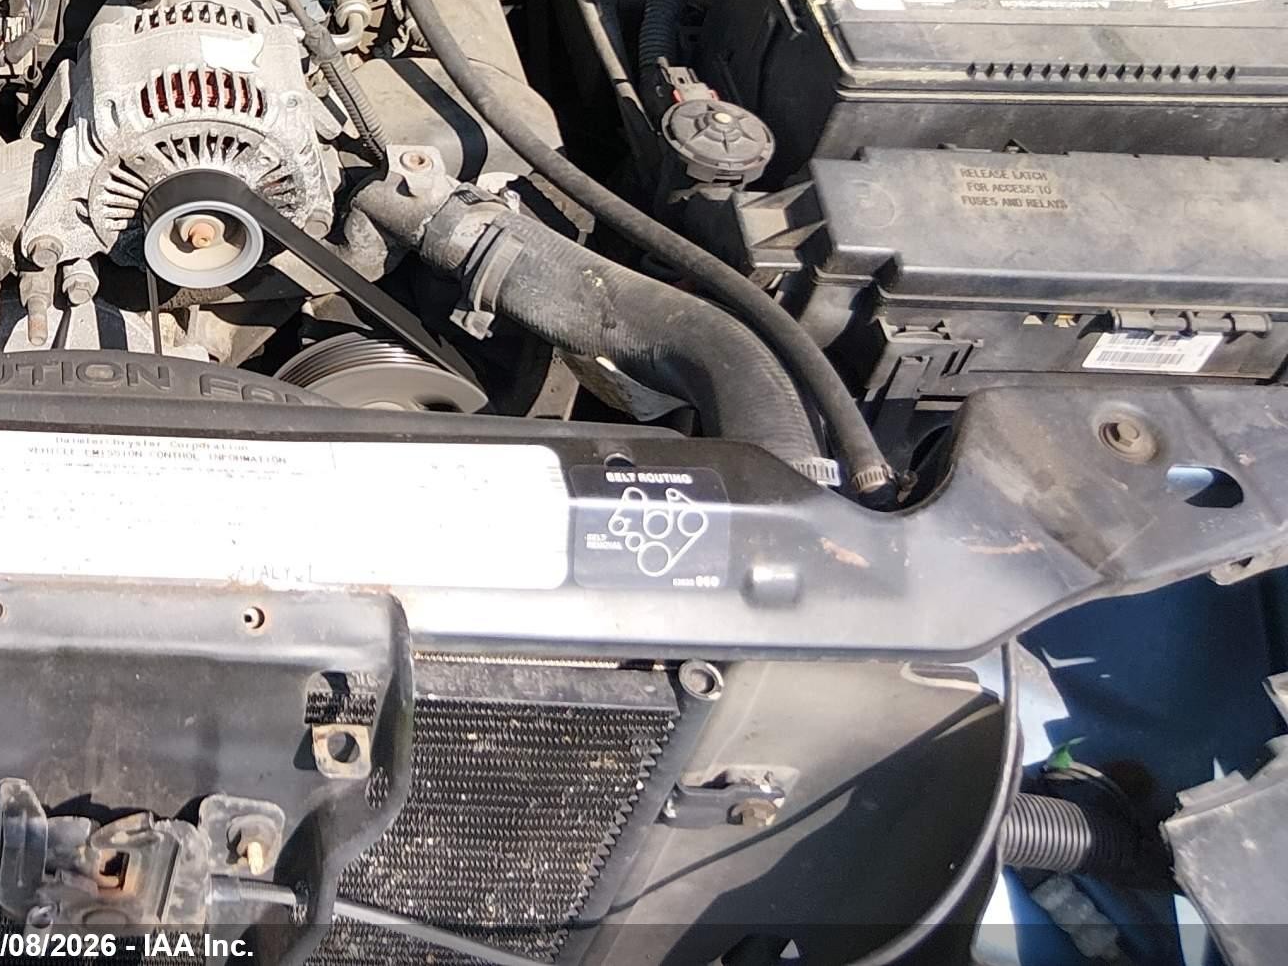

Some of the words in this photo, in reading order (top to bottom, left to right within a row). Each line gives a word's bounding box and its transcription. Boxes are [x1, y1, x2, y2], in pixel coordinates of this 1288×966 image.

[959, 168, 1010, 180] RELEASE
[1011, 170, 1048, 181] LATCH
[965, 181, 990, 193] FOR
[992, 183, 1035, 194] ACCESS
[1035, 185, 1053, 195] TO
[960, 195, 999, 207] FUSES
[1001, 197, 1023, 208] AND
[1025, 198, 1069, 210] RELAYS
[84, 449, 144, 459] EMISSION
[208, 453, 288, 464] INFORMATION
[605, 472, 637, 483] BELT
[637, 472, 694, 484] ROUTING
